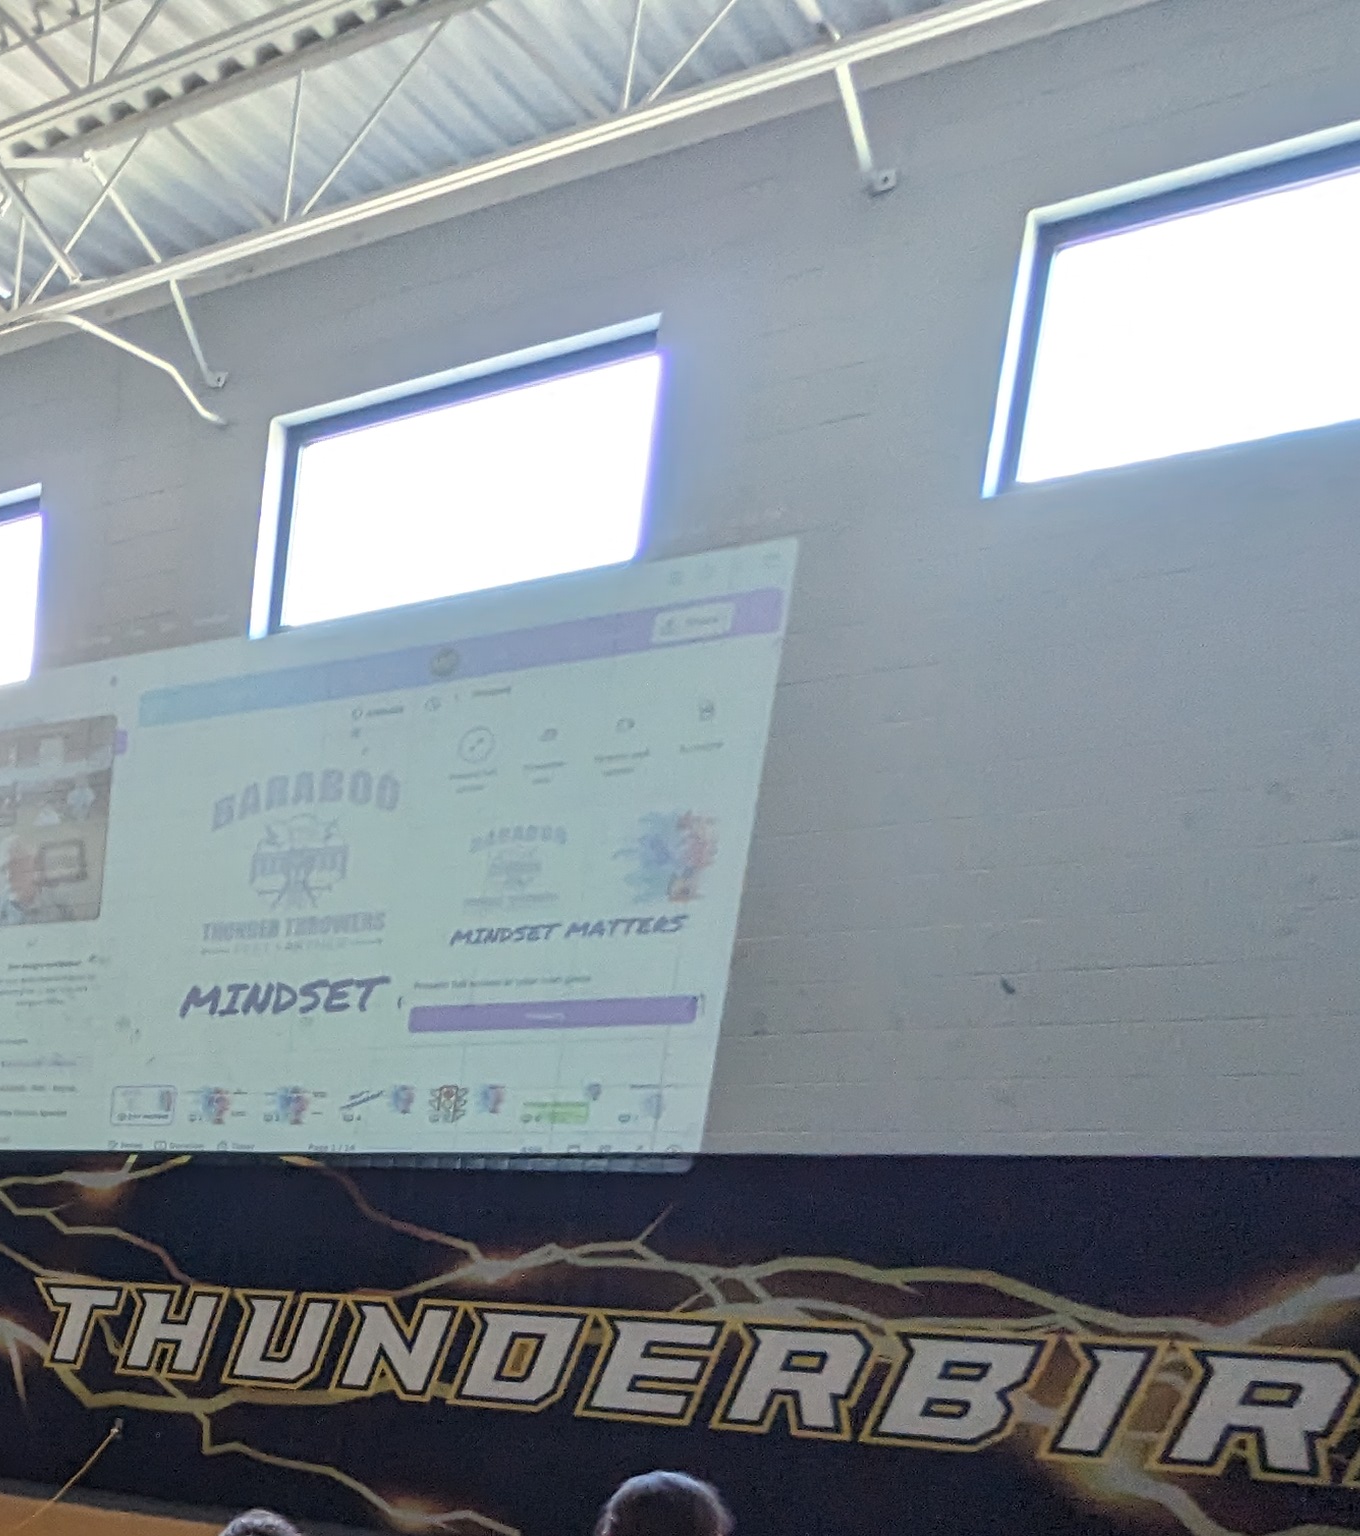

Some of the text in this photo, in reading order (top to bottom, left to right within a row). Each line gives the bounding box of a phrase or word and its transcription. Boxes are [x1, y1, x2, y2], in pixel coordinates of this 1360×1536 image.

[450, 914, 689, 947] MINDSET MATTERS
[179, 975, 392, 1019] MINDSET
[35, 1277, 1360, 1486] THUNDERBIR
